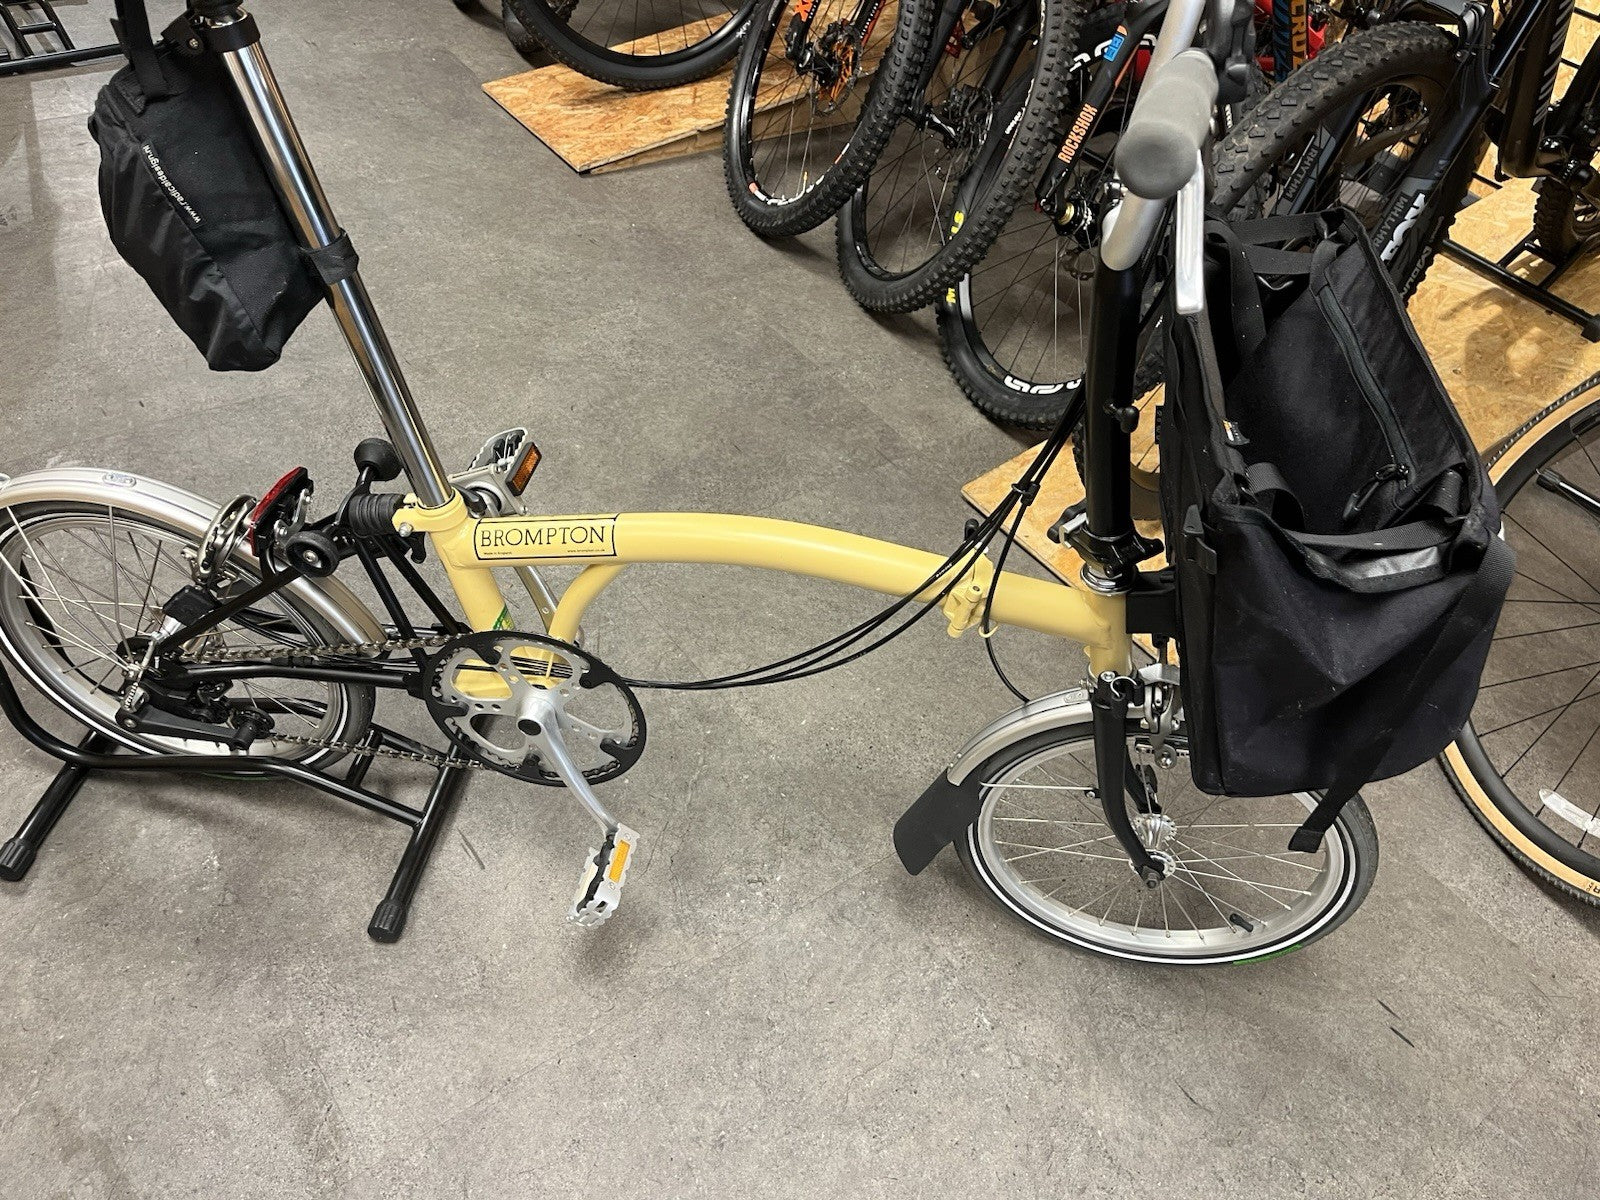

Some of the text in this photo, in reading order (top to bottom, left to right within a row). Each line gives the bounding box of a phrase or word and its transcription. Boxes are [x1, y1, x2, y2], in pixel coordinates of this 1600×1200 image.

[1057, 103, 1098, 164] ROCKSHOX
[143, 144, 201, 223] www.radicaldesign.nl
[1373, 195, 1409, 248] RHYTHM
[480, 526, 605, 547] BROMPTON
